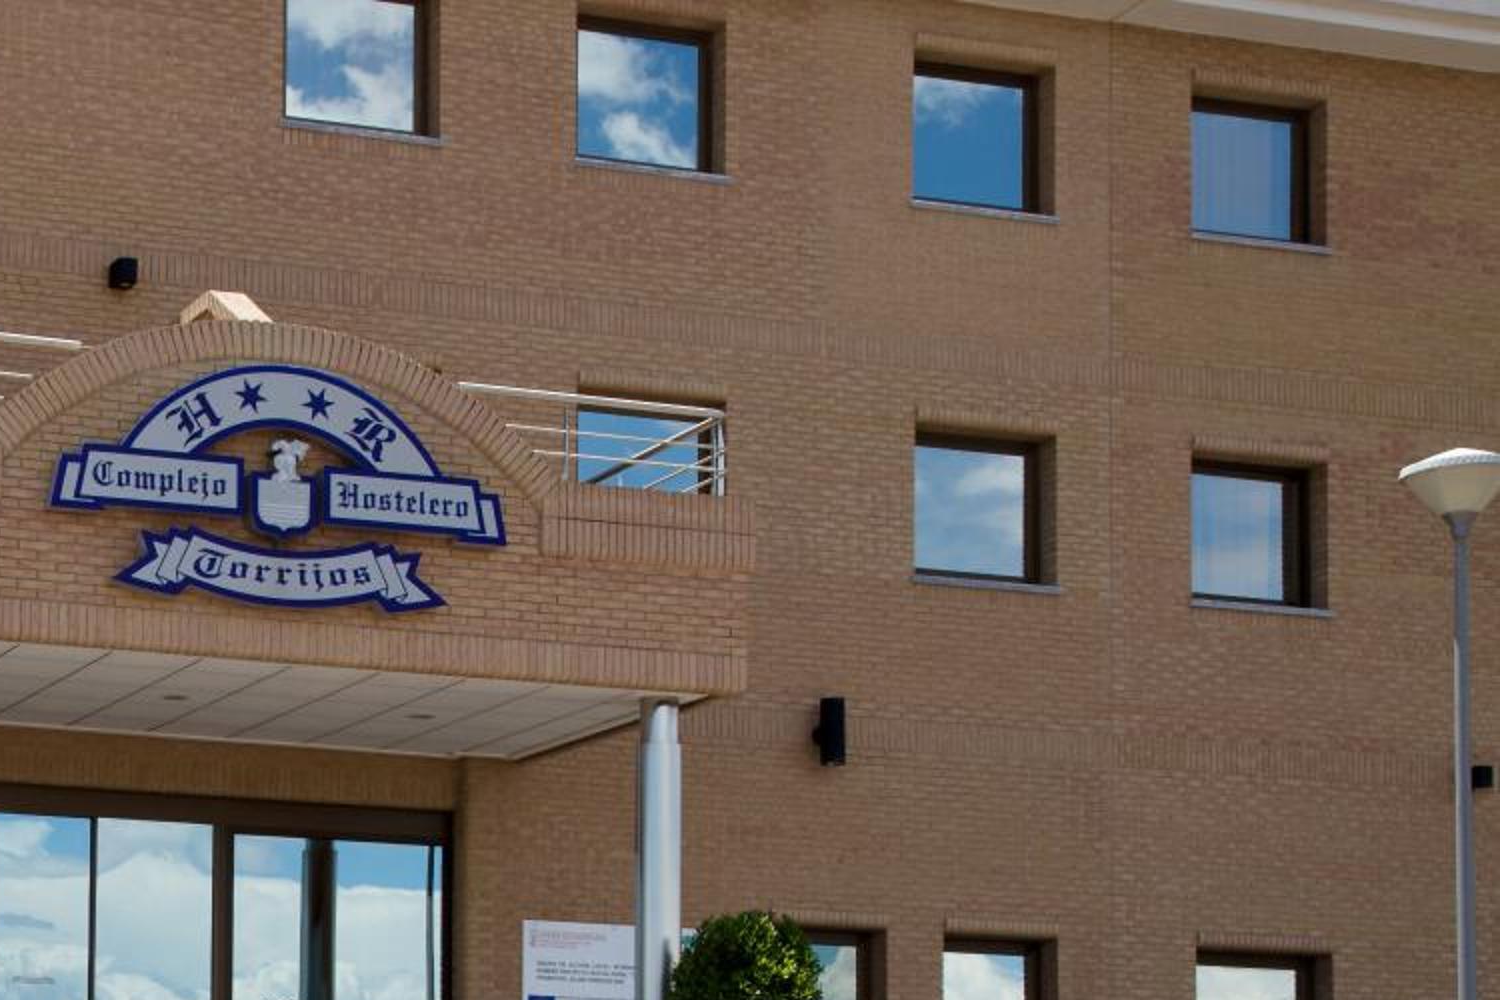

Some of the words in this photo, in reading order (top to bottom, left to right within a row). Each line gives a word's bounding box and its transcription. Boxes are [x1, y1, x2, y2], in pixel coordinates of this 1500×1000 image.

[165, 392, 222, 447] H
[92, 460, 227, 500] Complejo
[335, 481, 469, 519] Hostelero
[192, 547, 372, 591] Torrijos
